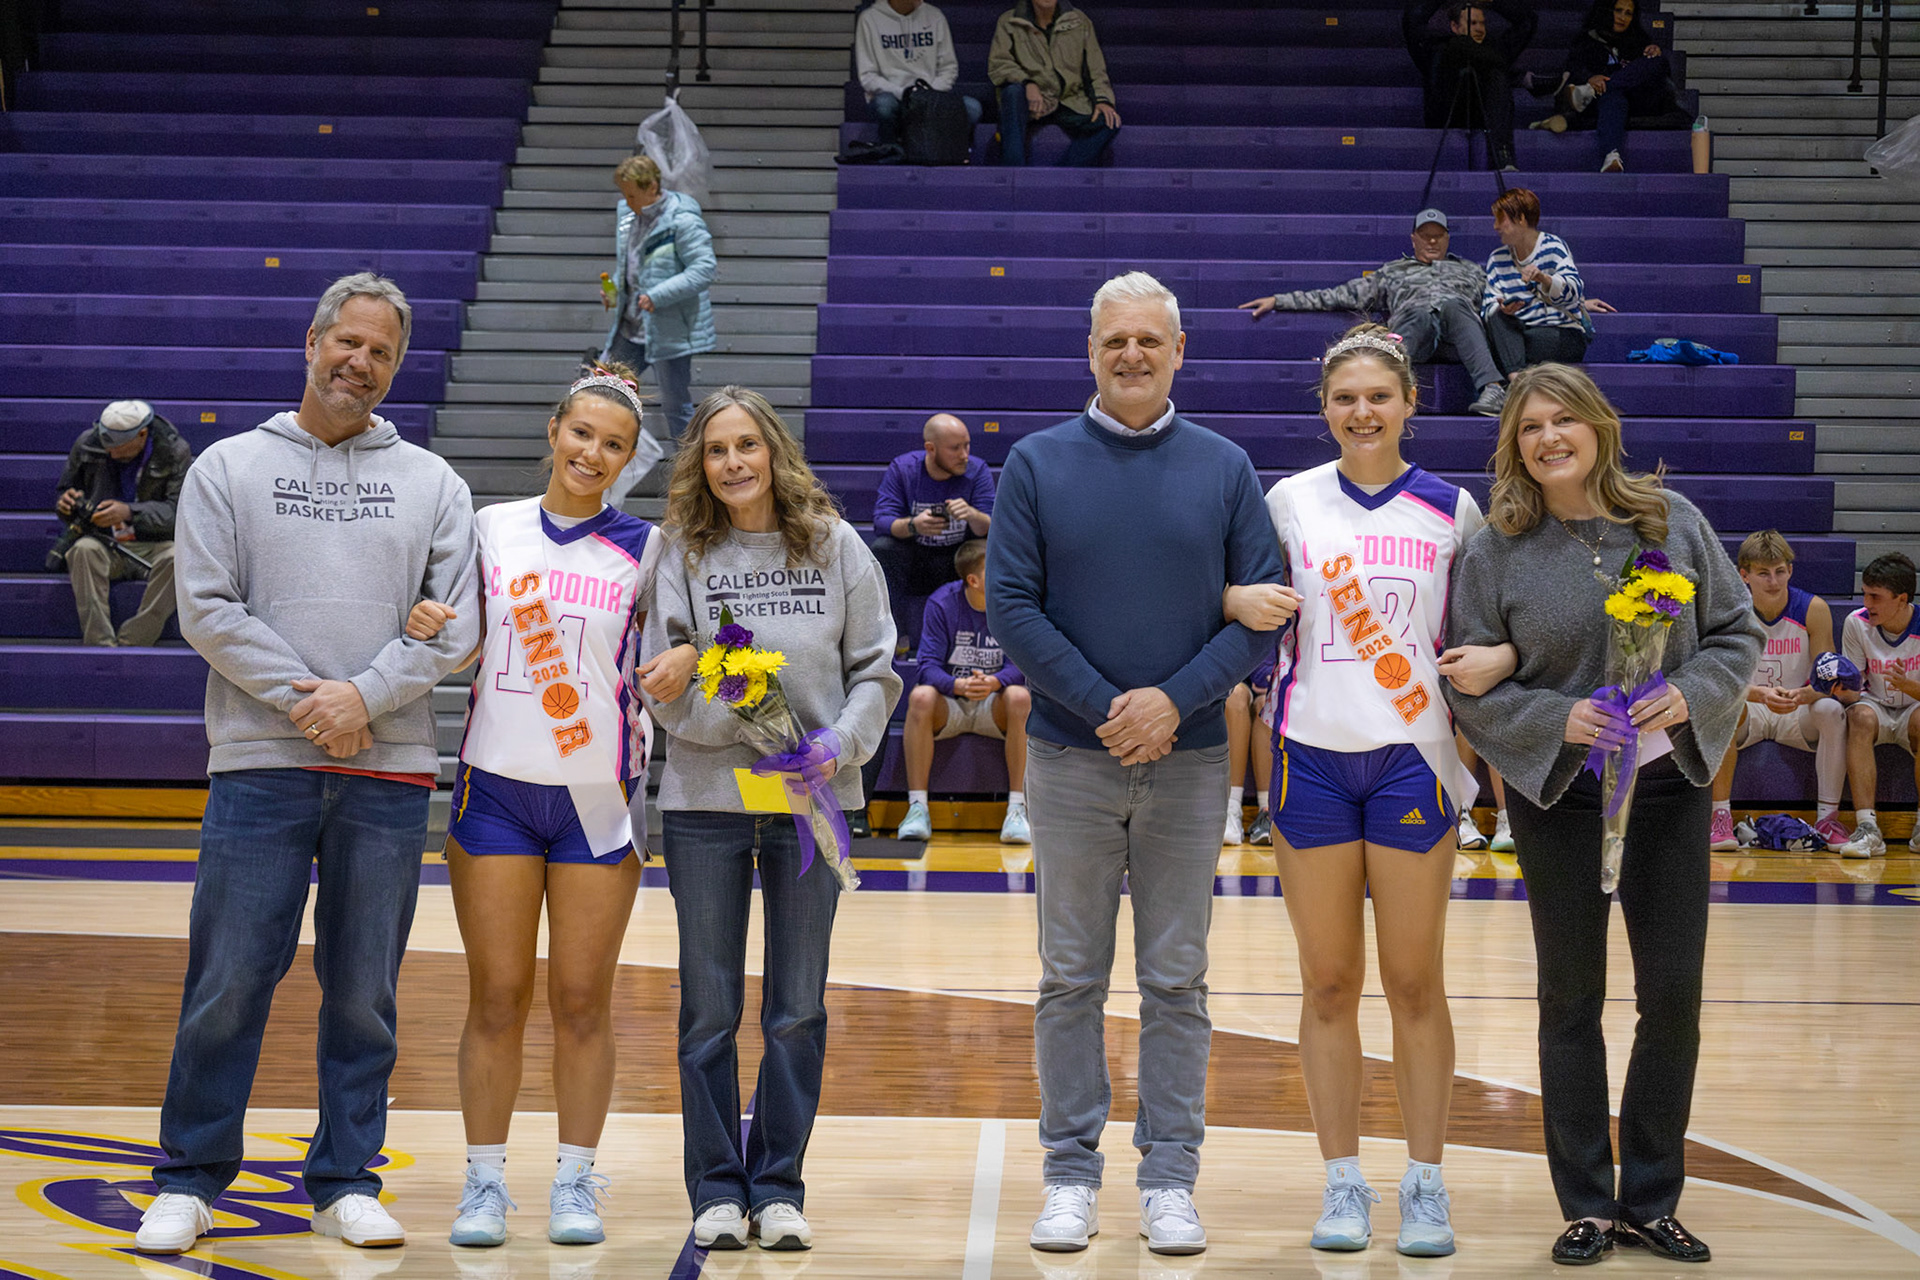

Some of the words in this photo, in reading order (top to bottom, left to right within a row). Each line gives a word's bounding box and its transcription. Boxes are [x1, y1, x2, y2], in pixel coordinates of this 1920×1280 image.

[275, 477, 394, 496] CALEDONIA
[275, 502, 395, 521] BASKETBALL
[491, 566, 624, 614] CDONIA
[706, 569, 825, 591] CALEDONIA
[742, 592, 770, 600] Fighting
[1357, 634, 1393, 661] 2026
[1763, 637, 1801, 655] DONIA
[532, 661, 569, 685] 2026
